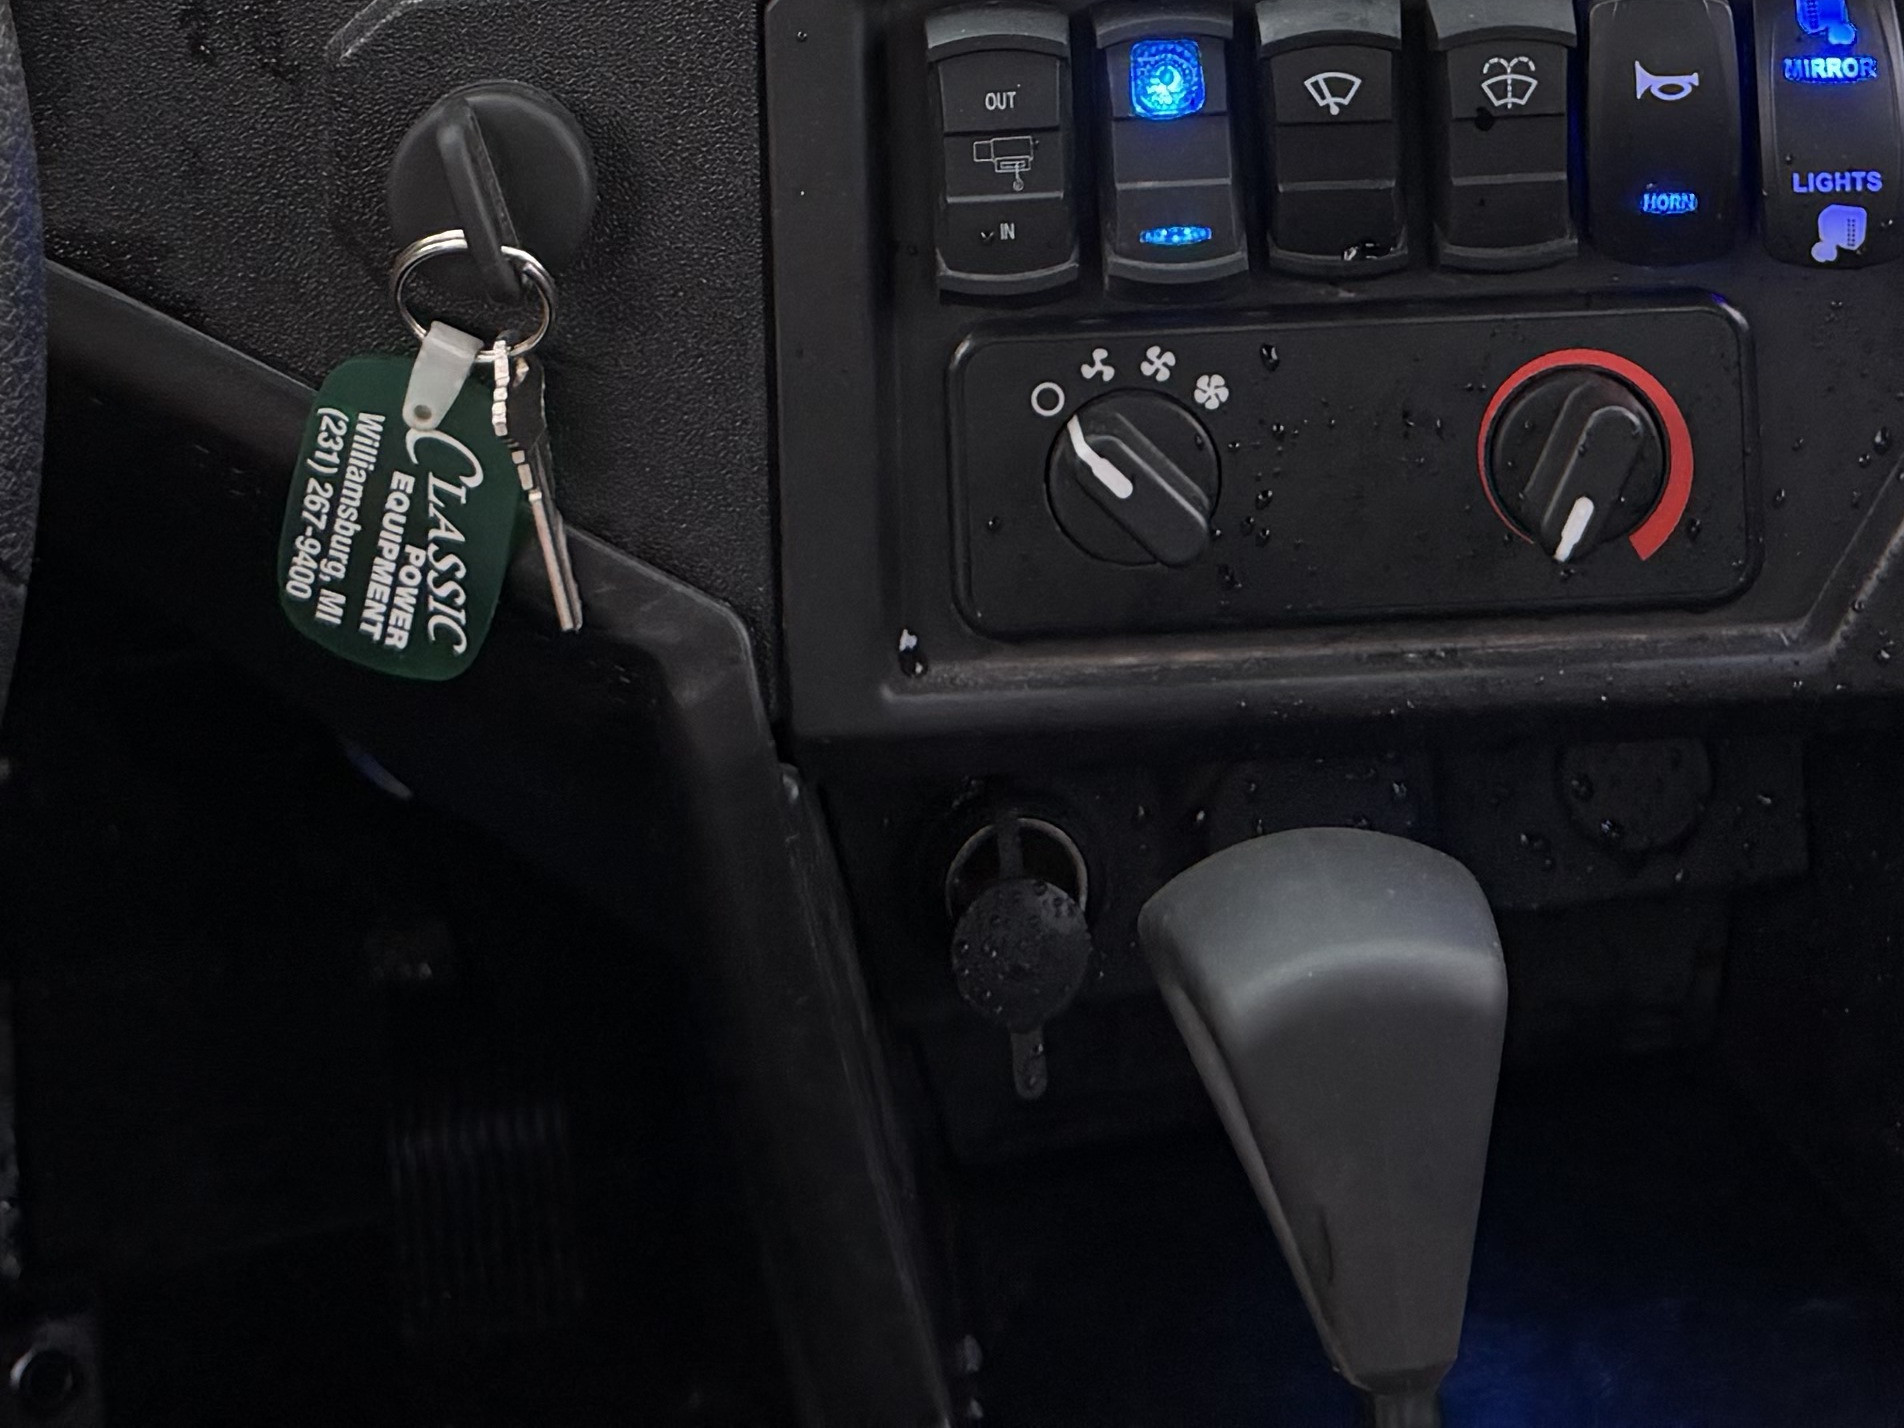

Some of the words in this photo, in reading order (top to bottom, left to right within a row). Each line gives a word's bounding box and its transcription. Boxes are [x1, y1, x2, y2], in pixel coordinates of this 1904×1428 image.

[1784, 56, 1878, 80] MIRROR
[985, 91, 1017, 110] OUT
[1792, 171, 1883, 193] LIGHTS
[1643, 193, 1697, 213] HORN
[1000, 223, 1015, 241] IN
[306, 407, 350, 474] (231)
[318, 412, 386, 582] Williamsburg,
[285, 477, 334, 599] 267-9400
[359, 470, 416, 641] EQUIPMENT
[315, 588, 346, 625] MI
[384, 544, 427, 649] POWER
